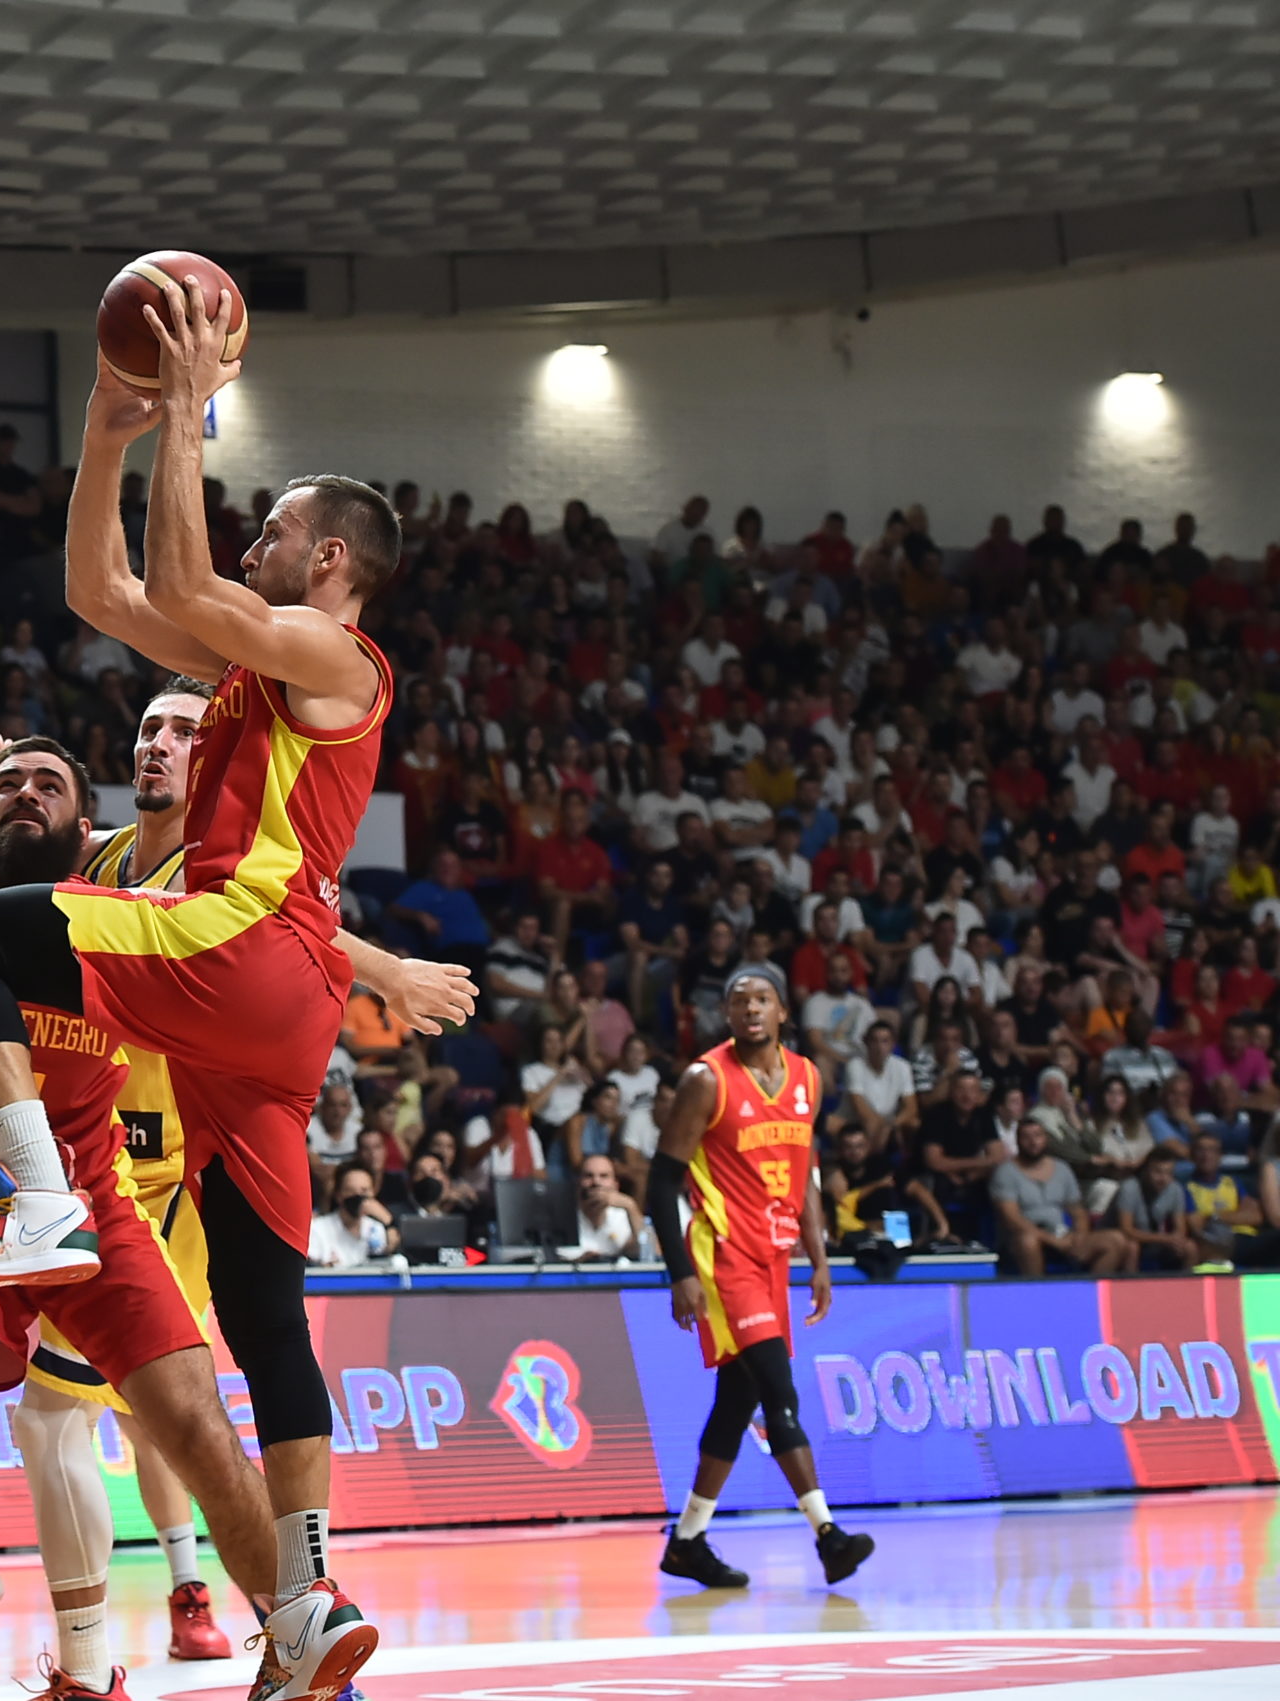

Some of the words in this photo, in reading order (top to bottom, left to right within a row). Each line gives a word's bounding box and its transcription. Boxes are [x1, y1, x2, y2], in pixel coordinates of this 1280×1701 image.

[759, 1159, 791, 1198] 55
[329, 1365, 466, 1455] PP
[813, 1340, 1242, 1436] DOWNLOAD
